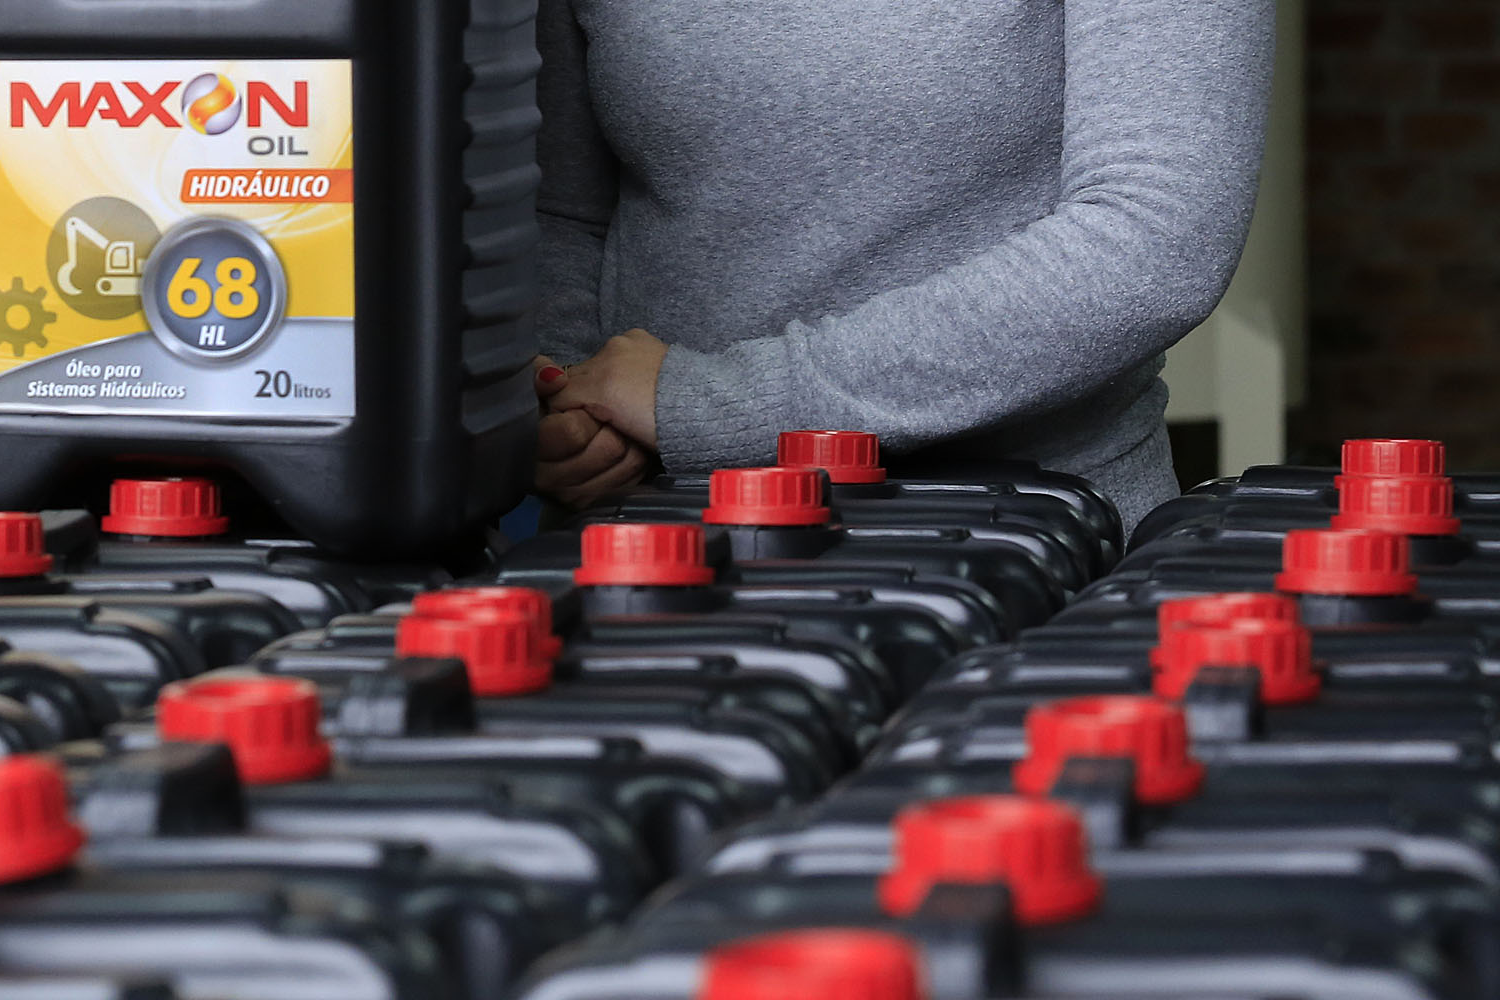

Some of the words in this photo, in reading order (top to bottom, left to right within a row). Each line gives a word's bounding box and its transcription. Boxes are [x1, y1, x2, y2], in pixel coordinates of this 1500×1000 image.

[9, 72, 309, 136] MAXON
[247, 136, 309, 156] OIL
[188, 171, 330, 198] HIDRÁULICO
[165, 256, 260, 319] 68
[198, 325, 227, 346] HL
[65, 358, 101, 378] Óleo
[103, 363, 142, 381] para
[26, 381, 97, 398] Sistemas
[99, 380, 187, 399] Hidráulicos
[254, 370, 292, 399] 20
[293, 383, 332, 399] litros
